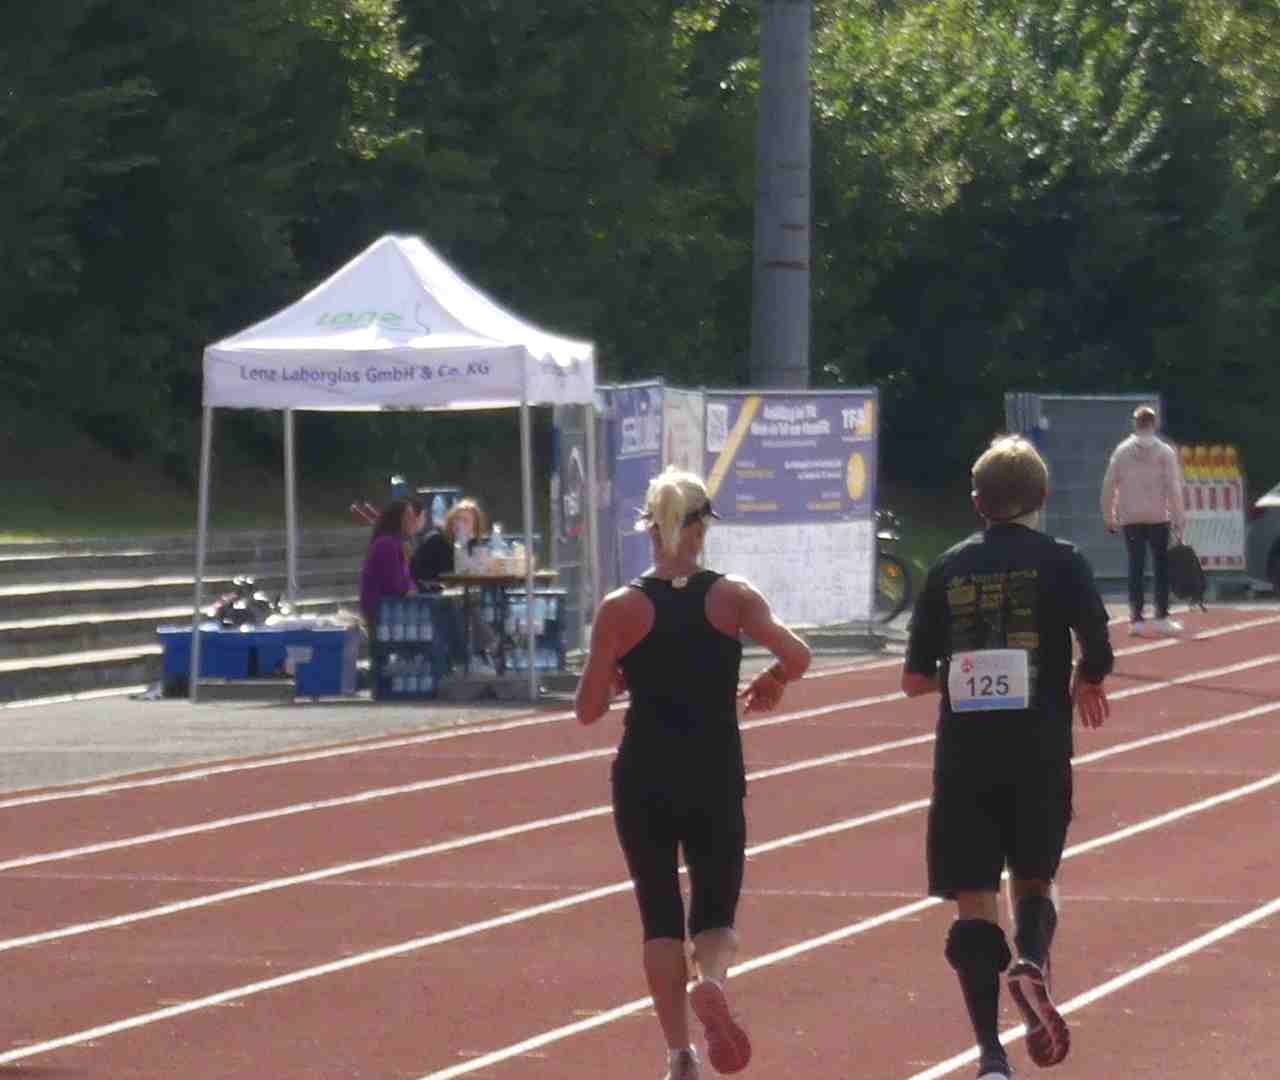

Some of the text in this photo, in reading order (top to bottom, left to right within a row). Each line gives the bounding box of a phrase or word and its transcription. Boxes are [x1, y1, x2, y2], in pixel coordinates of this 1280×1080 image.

[240, 366, 276, 382] Lenz
[282, 366, 361, 386] Laborglas
[366, 366, 415, 383] GmbH
[420, 366, 433, 380] &
[466, 362, 489, 376] KG
[965, 675, 1009, 697] 125
